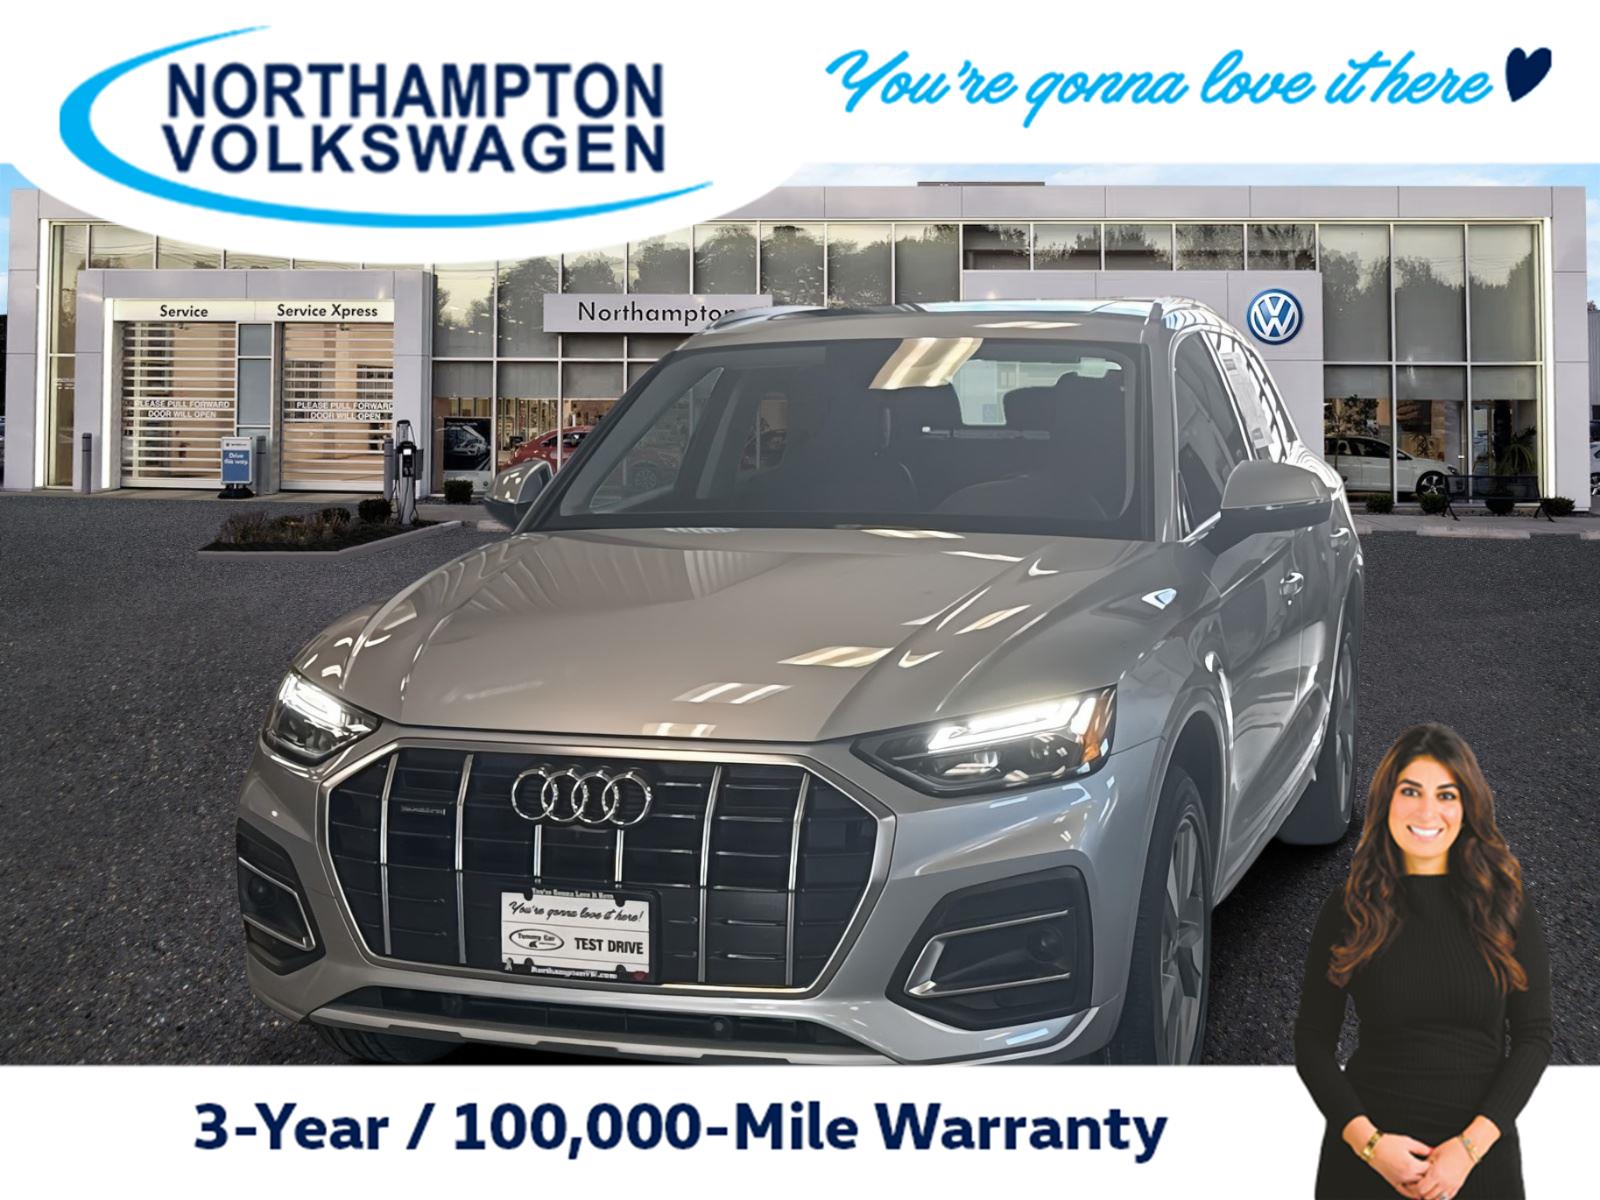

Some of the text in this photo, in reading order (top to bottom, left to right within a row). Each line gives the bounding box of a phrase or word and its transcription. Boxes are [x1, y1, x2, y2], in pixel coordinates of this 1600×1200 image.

[159, 305, 209, 318] Service
[277, 304, 378, 319] Service Xpress
[509, 901, 645, 922] You're gonna love it here!
[574, 937, 644, 955] TEST DRIVE
